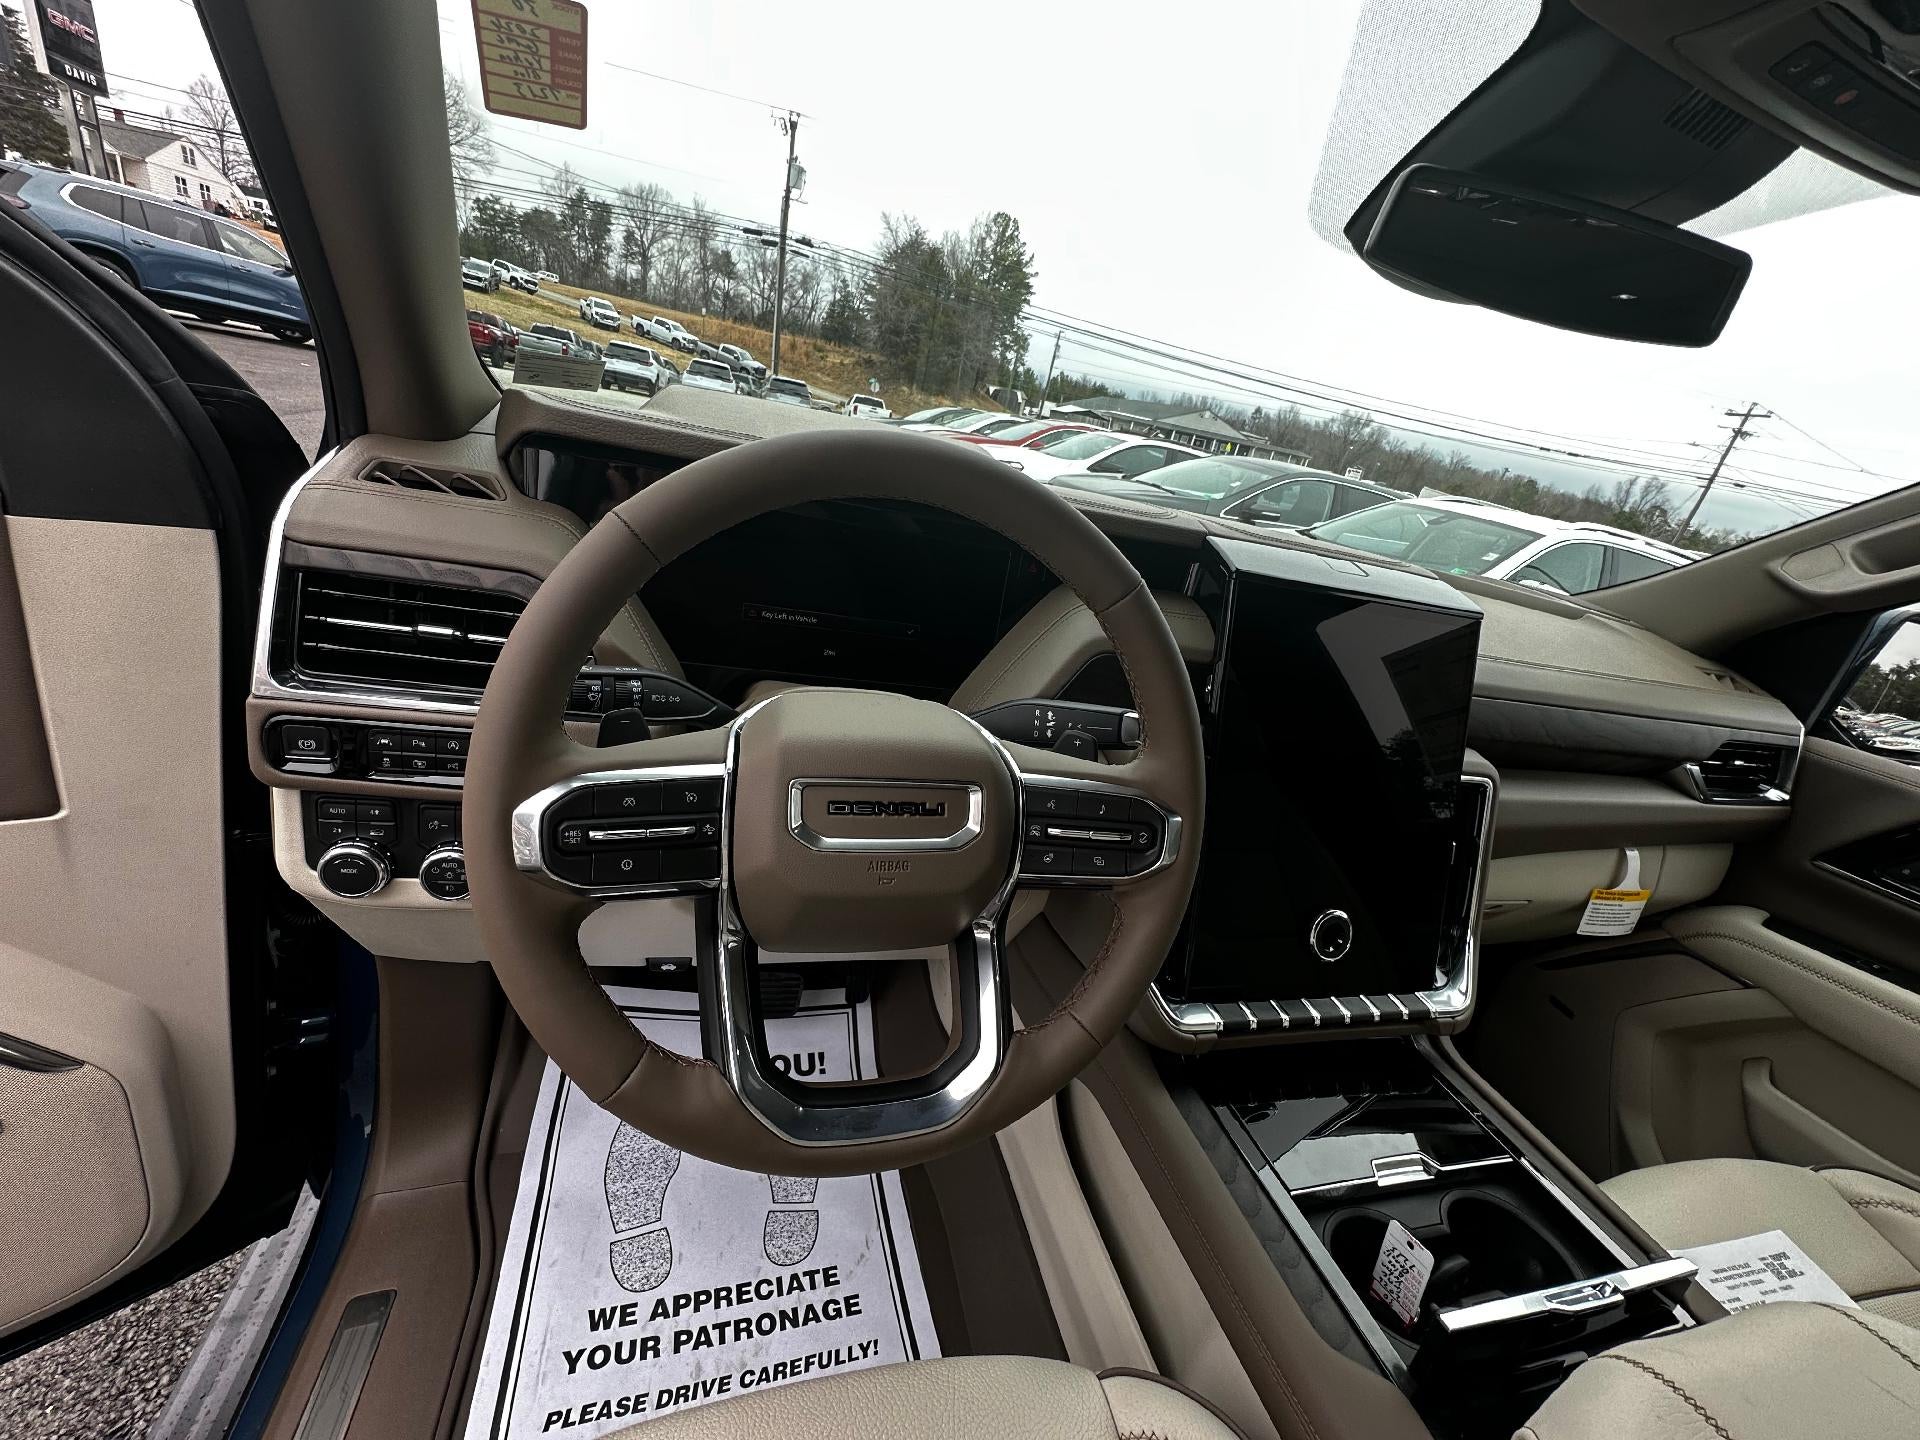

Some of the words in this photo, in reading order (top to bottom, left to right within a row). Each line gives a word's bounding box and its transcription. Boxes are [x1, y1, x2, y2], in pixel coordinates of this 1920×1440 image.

[47, 8, 95, 43] GMC
[64, 64, 97, 87] DAVIS
[796, 615, 818, 624] Vehicle
[1034, 719, 1040, 727] N
[1035, 709, 1040, 717] R
[827, 800, 946, 817] DENALI
[867, 860, 911, 873] AIRBAG
[770, 1051, 826, 1077] OU!
[587, 1302, 638, 1332] WE
[648, 1265, 841, 1323] APPRECIATE
[562, 1335, 661, 1375] YOUR
[673, 1293, 863, 1351] PATRONAGE
[541, 1392, 648, 1433] PLEASE
[655, 1374, 732, 1411] DRIVE
[739, 1338, 880, 1390] CAREFULLY!
